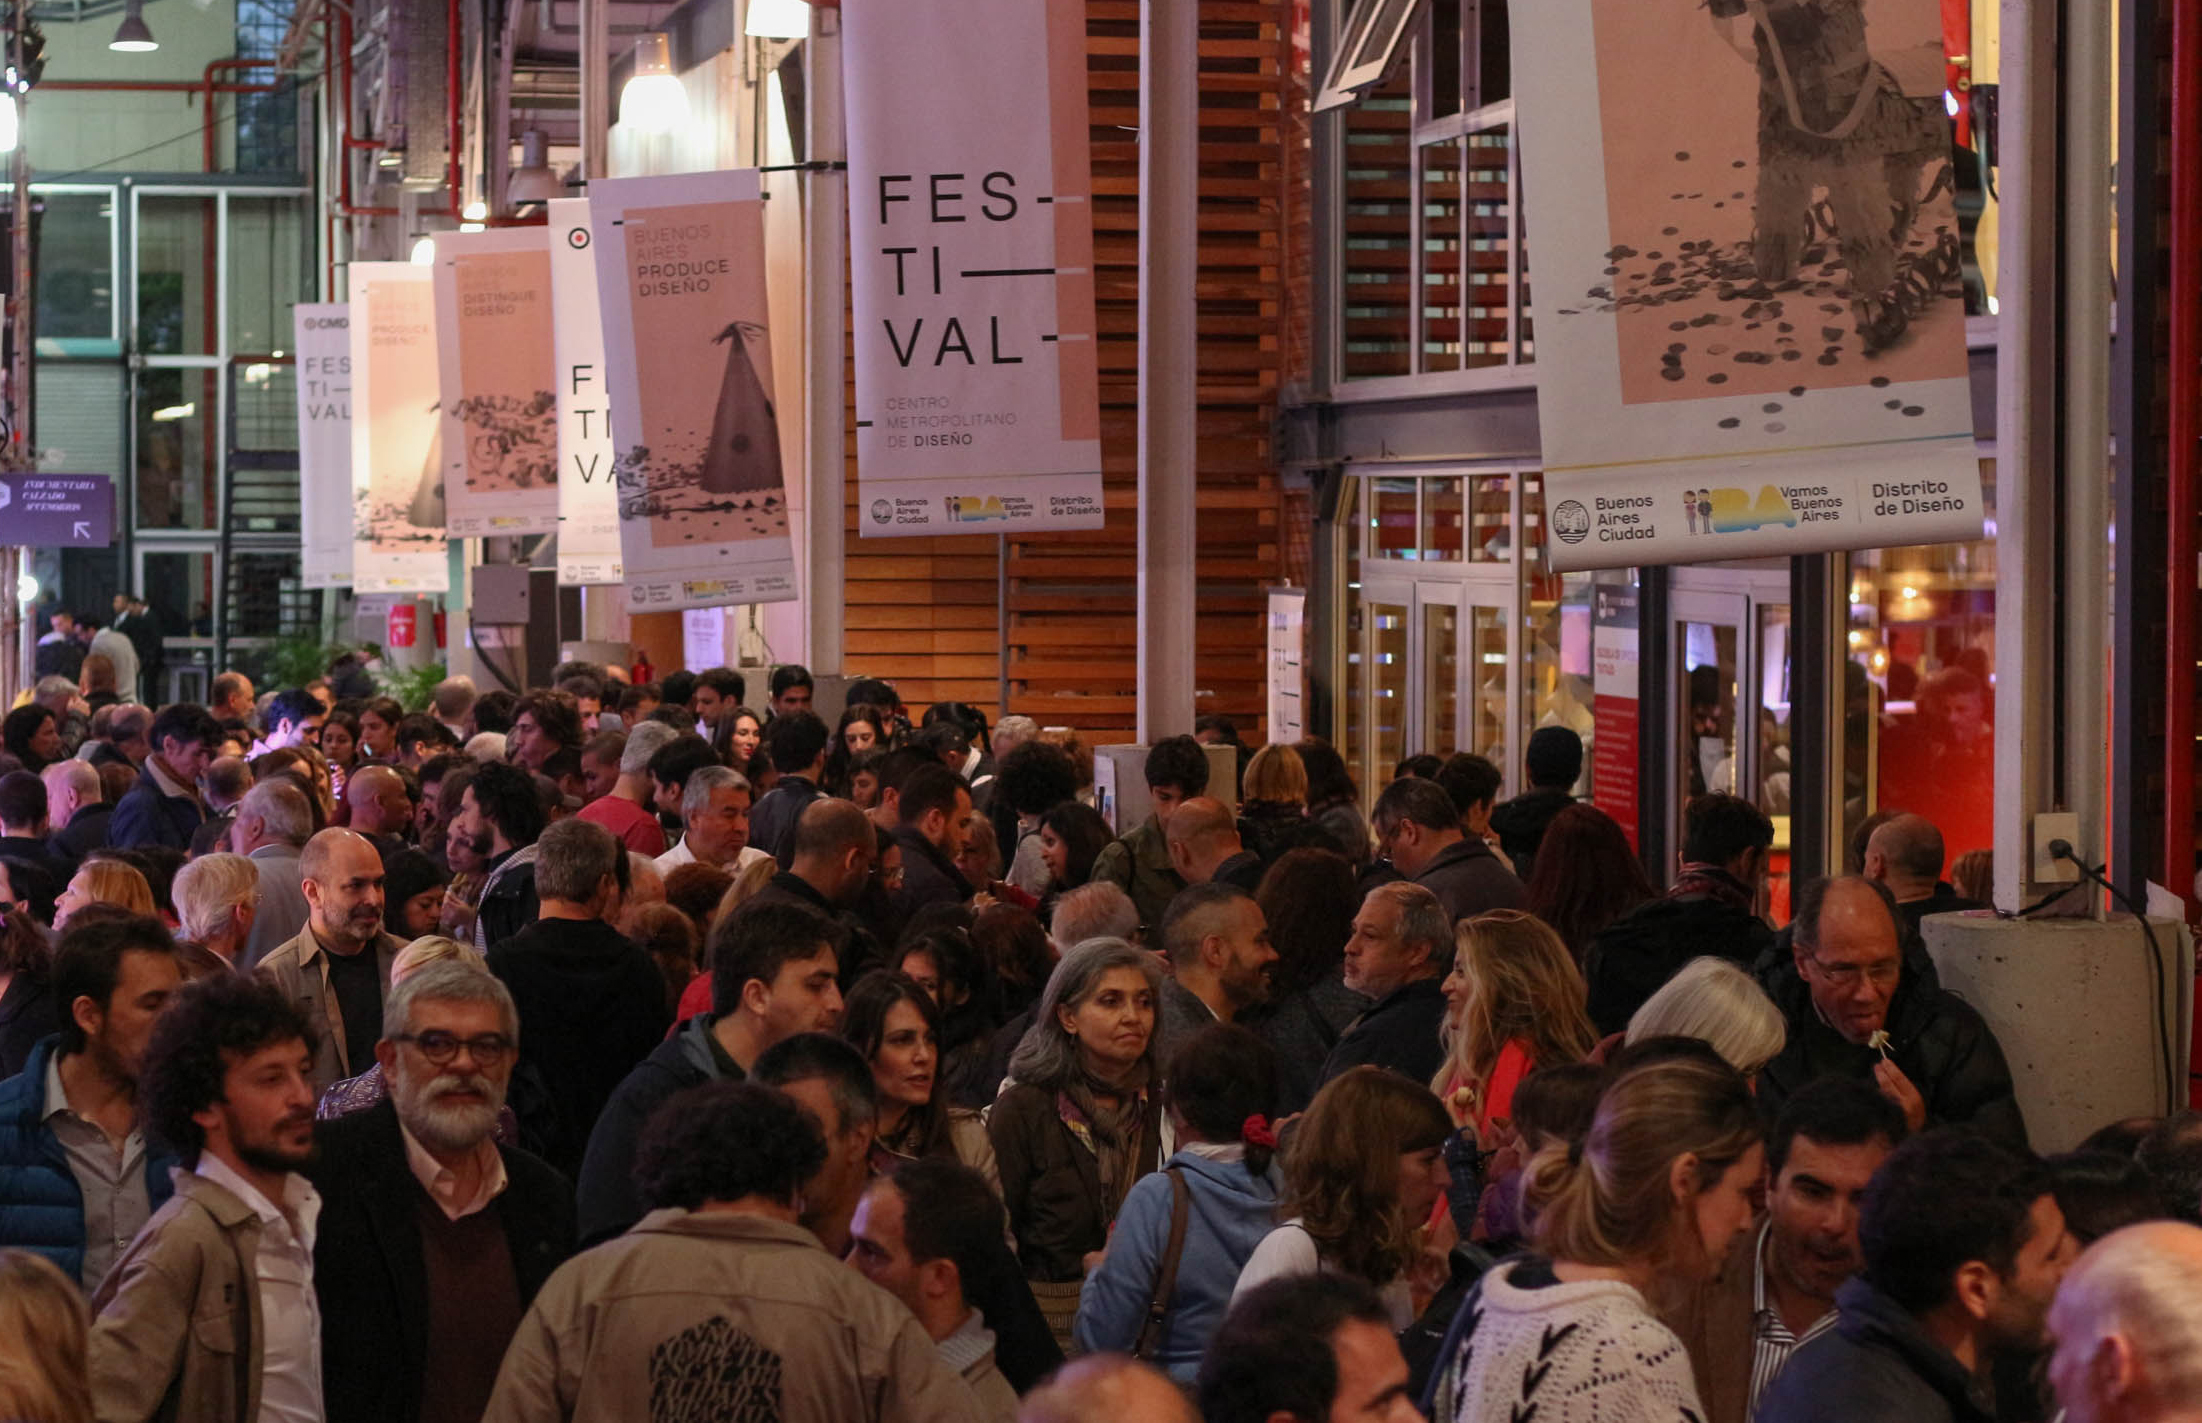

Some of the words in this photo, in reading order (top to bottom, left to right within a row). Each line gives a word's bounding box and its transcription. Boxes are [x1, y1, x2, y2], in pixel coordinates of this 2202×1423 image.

[635, 224, 711, 244] BUENOS
[636, 243, 689, 261] AIRES
[637, 259, 730, 278] PRODUCE
[639, 277, 711, 297] DISEÑO
[463, 290, 537, 304] DISTINGUE
[886, 396, 950, 410] CENTRO
[886, 412, 1017, 429] METROPOLITANO
[887, 435, 908, 448] DE
[914, 432, 973, 447] DISEÑO
[1780, 484, 1828, 498] Vamos
[1872, 479, 1948, 498] Distrito
[895, 498, 928, 506] Buenos
[1050, 496, 1093, 506] Distrito
[1595, 494, 1654, 511] Buenos
[1791, 495, 1843, 510] Buenos
[1874, 499, 1898, 516] de
[1902, 494, 1964, 513] Diseño
[896, 507, 920, 515] Aires
[1051, 507, 1064, 516] de
[1066, 504, 1102, 515] Diseño
[1801, 507, 1840, 522] Aires
[896, 515, 929, 524] Ciudad
[1598, 511, 1640, 526] Aires
[1598, 525, 1655, 542] Ciudad
